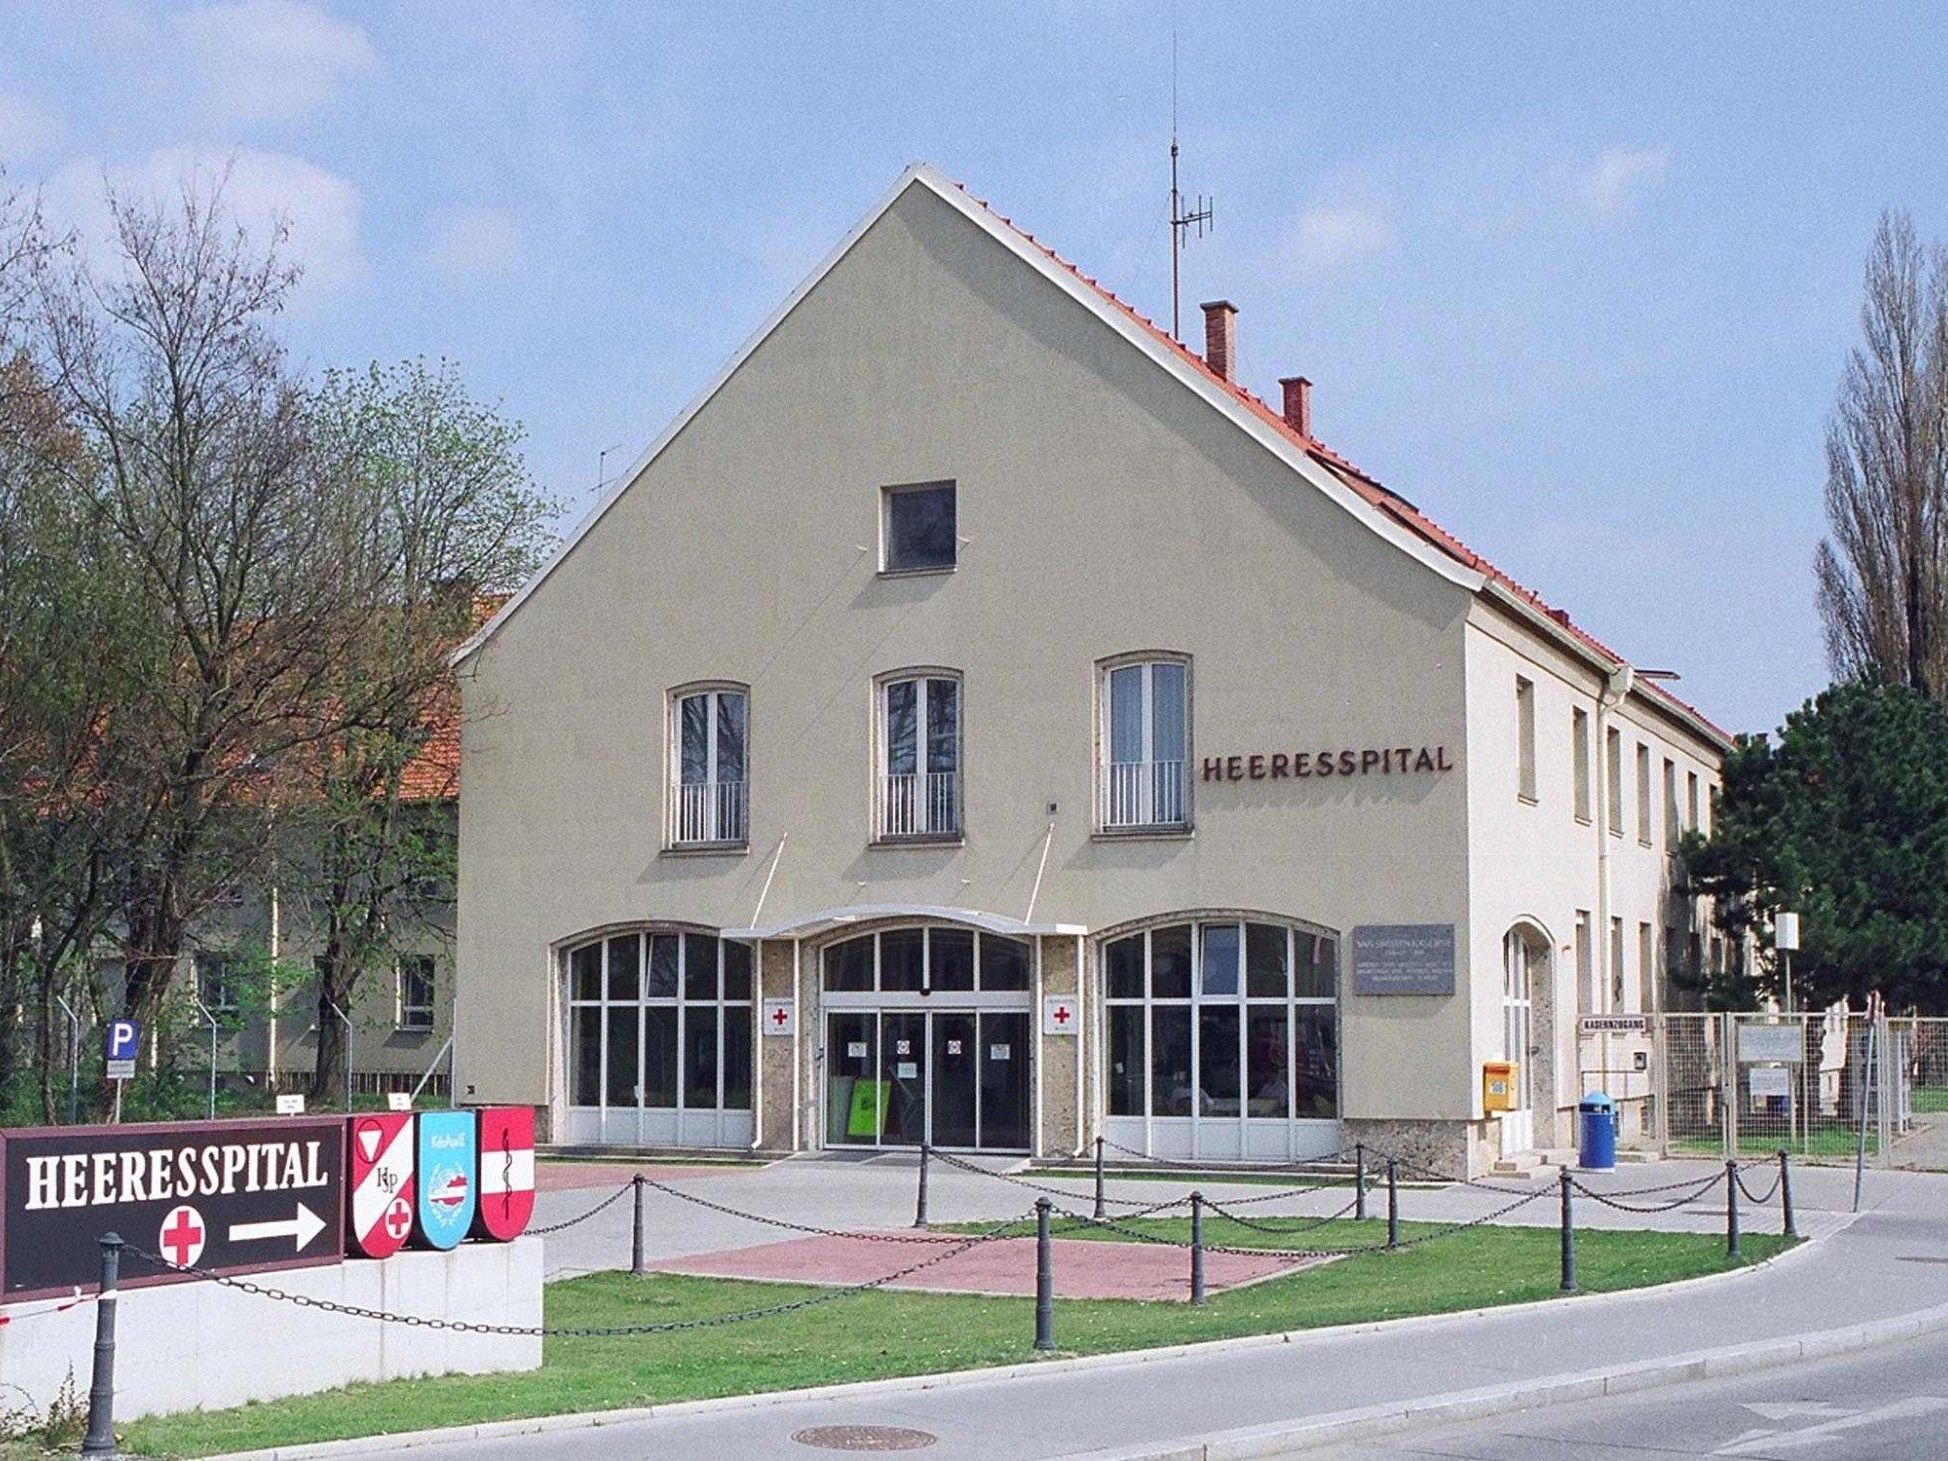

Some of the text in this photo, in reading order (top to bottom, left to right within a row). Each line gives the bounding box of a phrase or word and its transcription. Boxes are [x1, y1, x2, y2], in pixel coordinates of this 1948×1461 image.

[1202, 746, 1453, 782] HEERESSPITAL
[113, 1023, 133, 1056] P
[24, 1141, 328, 1210] HEERESSPITAL
